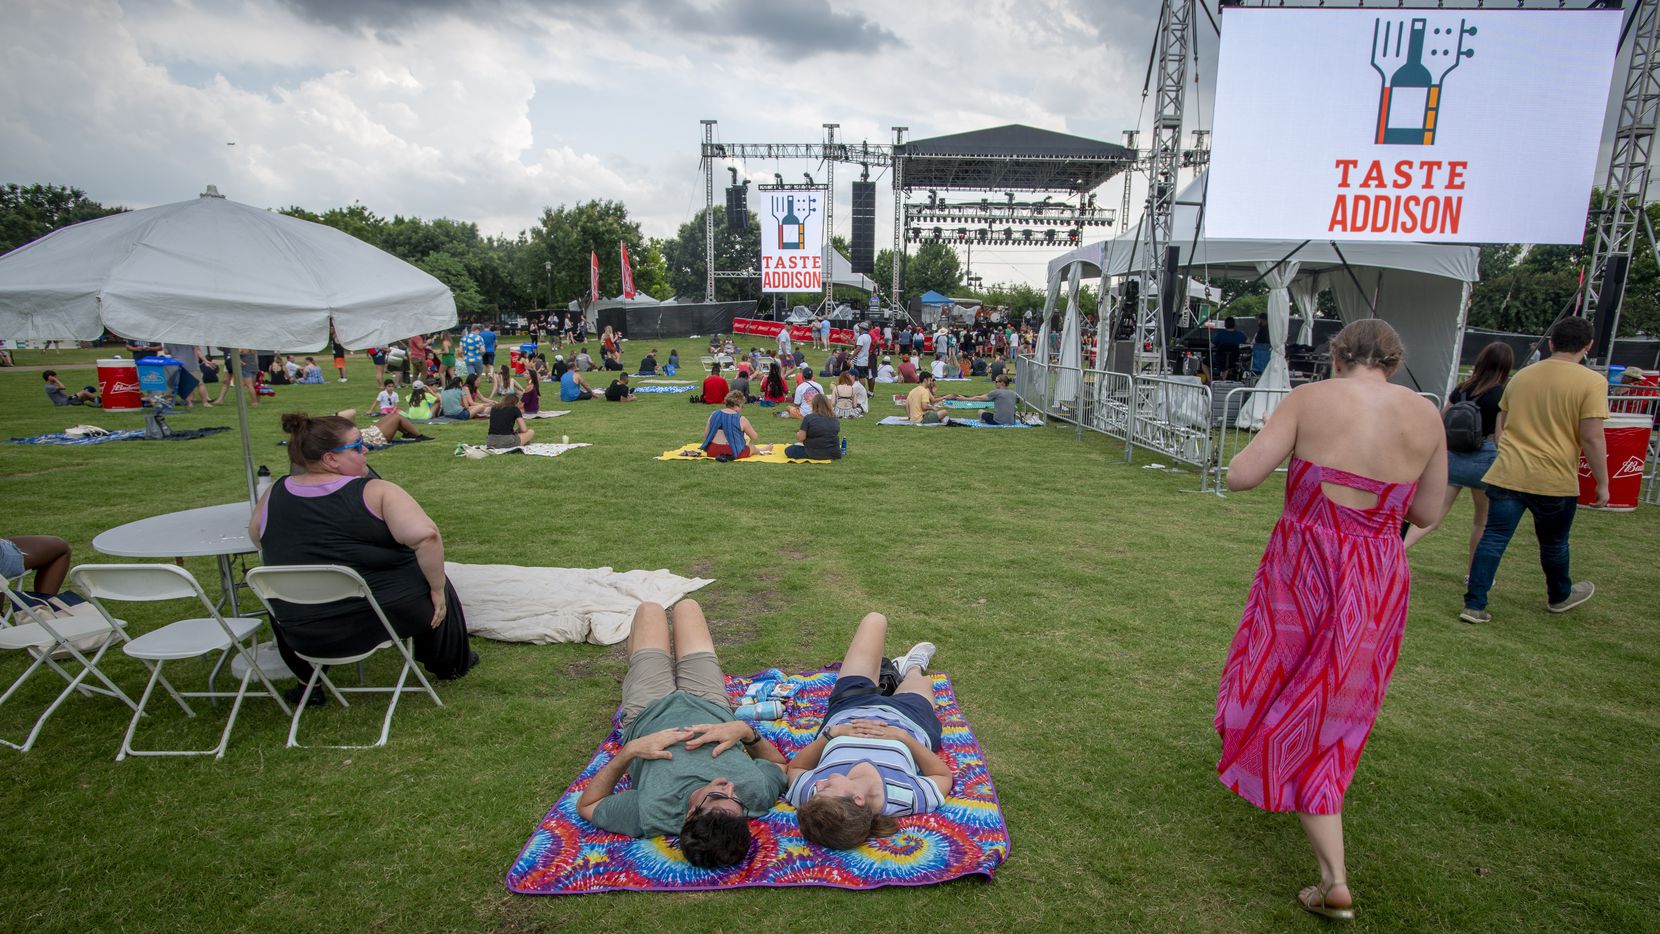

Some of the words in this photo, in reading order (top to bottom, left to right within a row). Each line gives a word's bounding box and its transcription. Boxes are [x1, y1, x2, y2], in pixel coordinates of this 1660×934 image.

[1335, 159, 1468, 190] TASTE
[1328, 194, 1463, 234] ADDISON
[762, 256, 821, 269] TASTE
[763, 271, 821, 289] ADDISON
